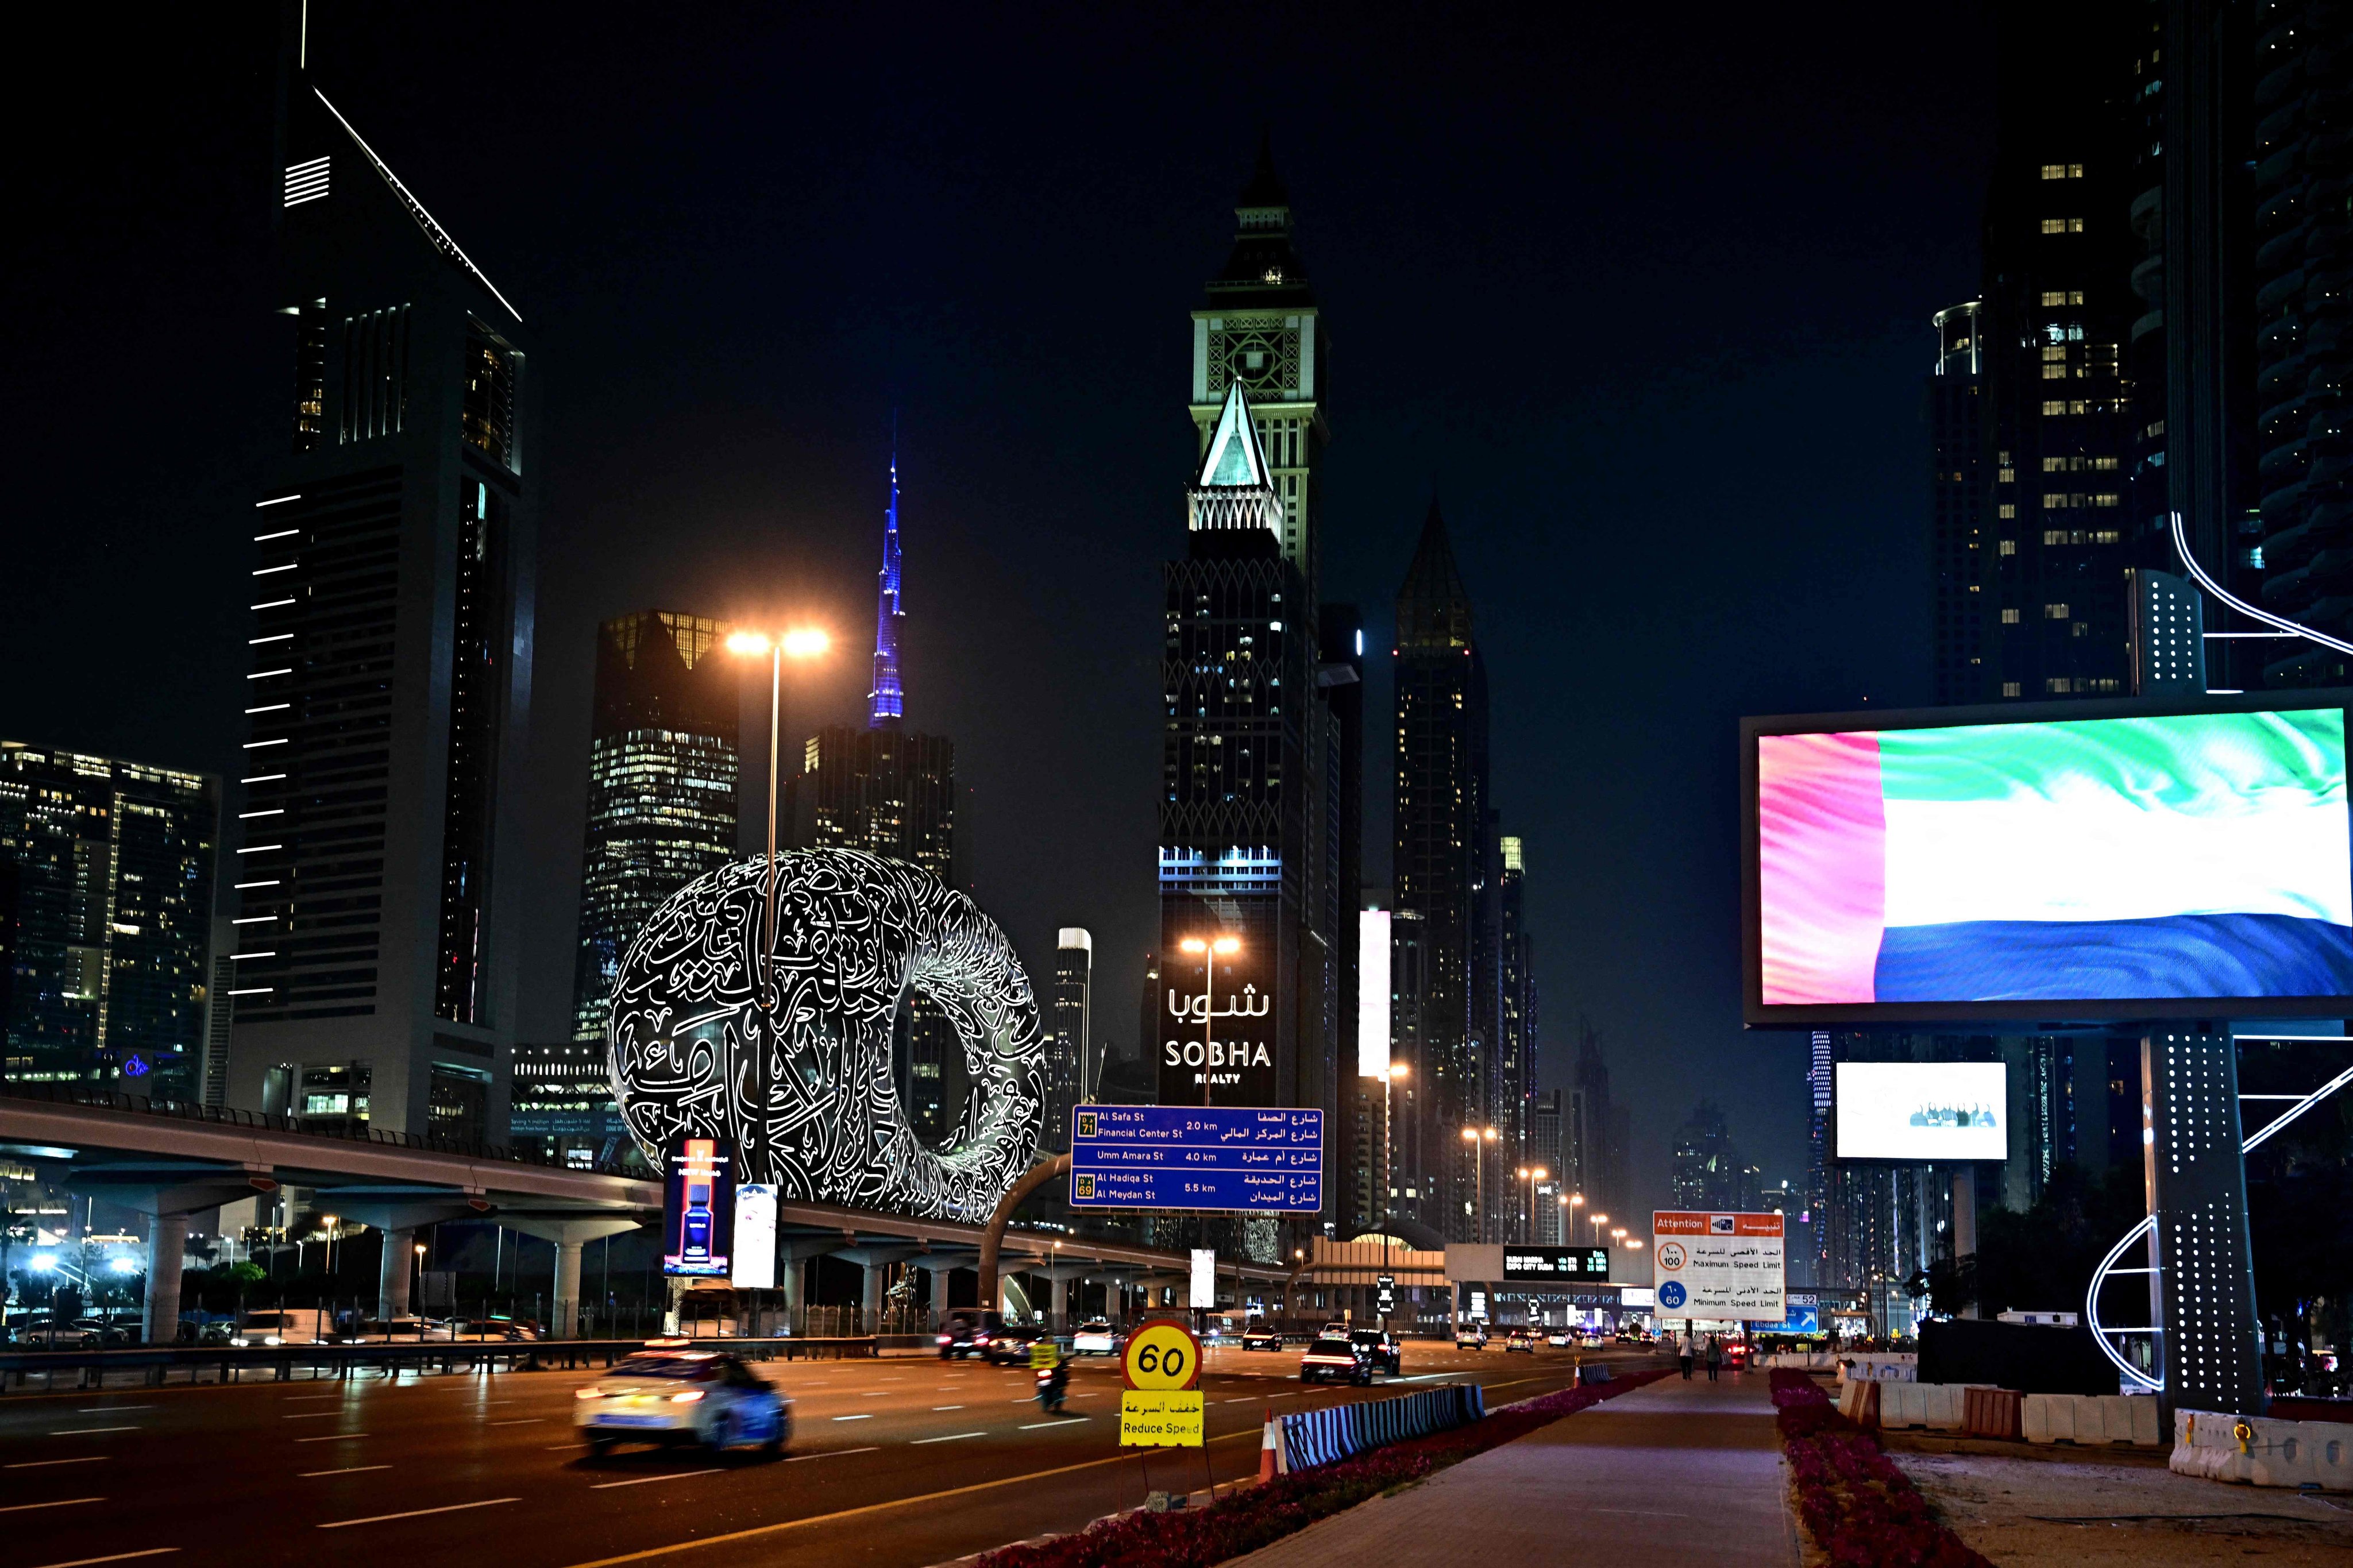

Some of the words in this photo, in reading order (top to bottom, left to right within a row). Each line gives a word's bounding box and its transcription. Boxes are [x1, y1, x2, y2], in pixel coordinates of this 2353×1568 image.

[1168, 983, 1270, 1024] شوبا
[1165, 1040, 1271, 1067] SOBHA
[1195, 1073, 1240, 1084] REALTY
[1112, 1113, 1131, 1121] Safa
[1135, 1113, 1144, 1121] St
[1258, 1113, 1286, 1121] الصفا
[1292, 1113, 1317, 1124] شارع
[1082, 1123, 1093, 1134] 71
[1187, 1122, 1200, 1130] 2.0
[1204, 1122, 1217, 1130] km
[1098, 1128, 1136, 1137] Financial
[1140, 1129, 1169, 1137] Center
[1173, 1129, 1182, 1138] St
[1221, 1128, 1249, 1141] المالي
[1255, 1129, 1285, 1140] المركز
[1291, 1130, 1317, 1142] شارع
[1098, 1151, 1119, 1159] Umm
[1123, 1152, 1150, 1160] Amara
[1154, 1152, 1163, 1160] St
[1186, 1153, 1199, 1161] 4.0
[1243, 1152, 1269, 1163] عمارة
[1276, 1150, 1284, 1165] أم
[1291, 1153, 1317, 1165] شارع
[1097, 1173, 1106, 1181] Al
[1110, 1173, 1139, 1184] Hadiqa
[1144, 1174, 1152, 1183] St
[1244, 1175, 1284, 1185] الحديقة
[1290, 1176, 1316, 1188] شارع
[1079, 1185, 1091, 1196] 69
[1185, 1184, 1198, 1192] 5.5
[1109, 1190, 1142, 1200] Meydan
[1145, 1191, 1155, 1199] St
[1251, 1191, 1283, 1202] الميدان
[1290, 1193, 1316, 1204] شارع
[1657, 1219, 1702, 1228] Attention
[1697, 1248, 1725, 1256] للسرعة
[1731, 1248, 1757, 1257] الأقصى
[1664, 1257, 1680, 1265] 100
[1734, 1261, 1758, 1269] Speed
[1667, 1285, 1677, 1293] ٦٠
[1703, 1287, 1731, 1295] للسرعة
[1737, 1287, 1758, 1295] الأدنى
[1666, 1296, 1679, 1304] 60
[1803, 1295, 1814, 1304] 52
[1782, 1321, 1791, 1329] St
[1138, 1344, 1184, 1377] 60
[1125, 1402, 1164, 1415] السرعة
[1170, 1404, 1199, 1412] خفف
[1125, 1423, 1162, 1433] Reduce
[1166, 1423, 1199, 1435] Speed
